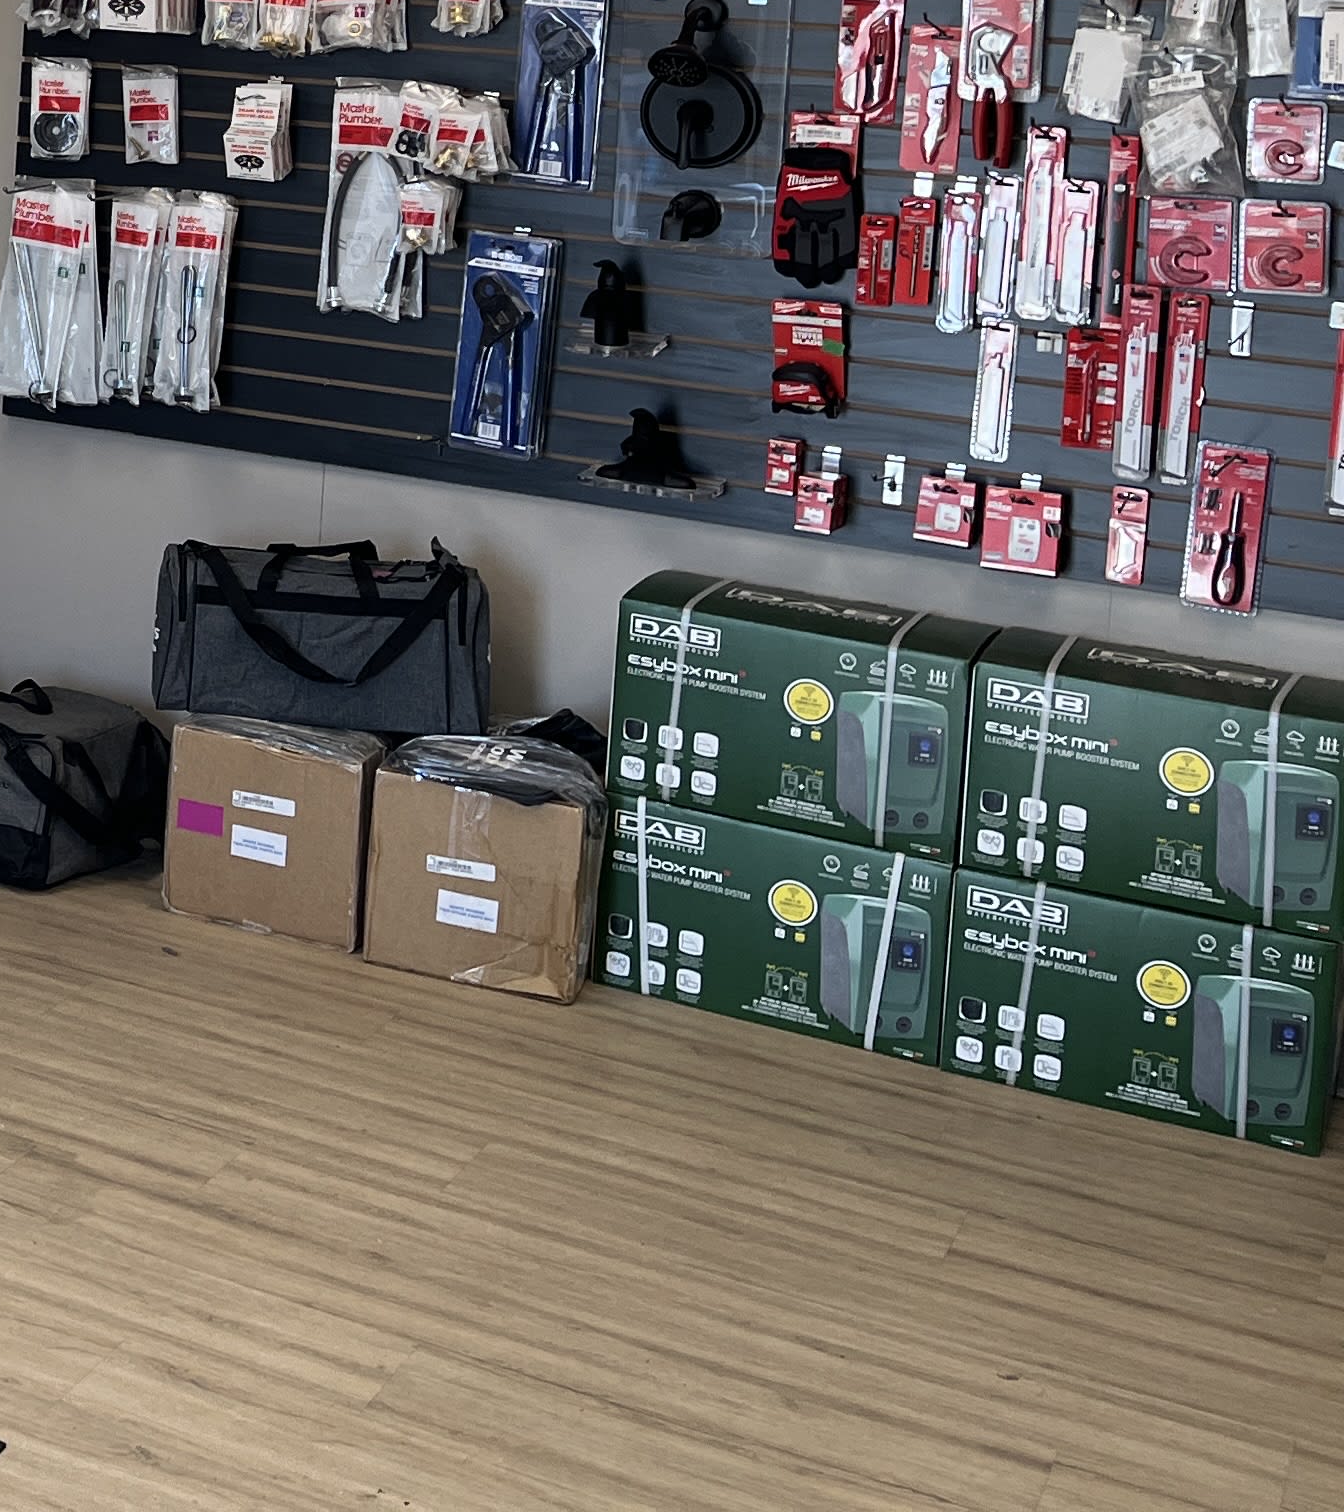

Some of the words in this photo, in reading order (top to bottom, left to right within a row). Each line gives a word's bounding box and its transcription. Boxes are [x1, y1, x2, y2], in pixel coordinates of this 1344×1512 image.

[339, 113, 383, 125] Plumber
[340, 102, 375, 114] Master
[14, 208, 56, 224] Plumber
[15, 197, 50, 212] Master
[1124, 388, 1144, 434] TORCH
[1169, 396, 1191, 441] TORCH
[634, 618, 716, 646] DAB
[627, 653, 702, 677] esybox
[705, 668, 738, 684] mini
[739, 688, 767, 701] SYSTEM
[992, 683, 1084, 713] DAB
[985, 720, 1068, 746] esybox
[1071, 736, 1109, 754] mini
[1053, 747, 1075, 759] PUMP
[1075, 751, 1109, 765] BOOSTER
[1110, 758, 1140, 771] SYSTEM
[619, 814, 701, 845] DAB
[613, 850, 686, 875] esbox
[689, 866, 723, 884] mini
[693, 880, 724, 895] BOOSTER
[724, 887, 752, 901] SYSTEM
[972, 890, 1063, 924] DAB
[964, 928, 1047, 956] esybox
[1049, 946, 1087, 964] mini
[1053, 961, 1088, 976] BOOSTER
[1088, 968, 1118, 983] SYSTEM
